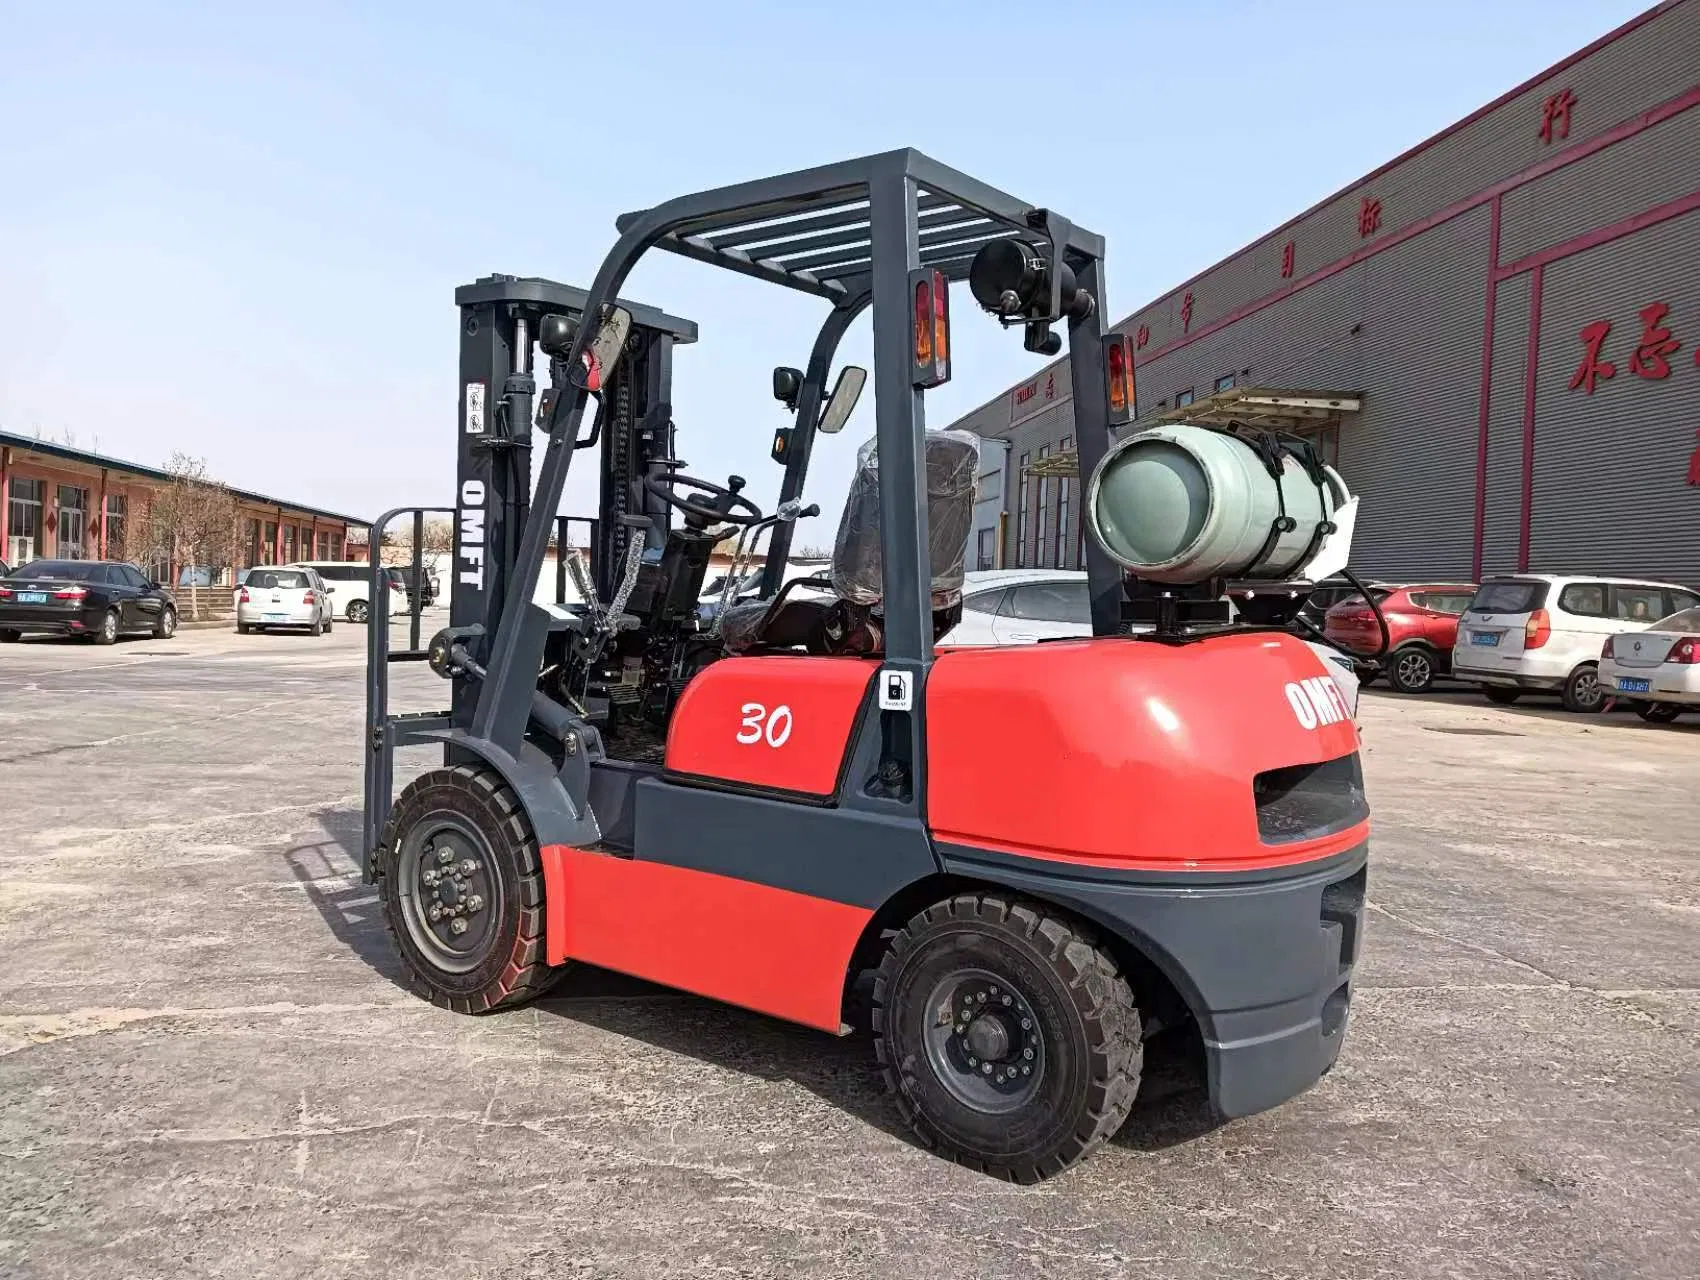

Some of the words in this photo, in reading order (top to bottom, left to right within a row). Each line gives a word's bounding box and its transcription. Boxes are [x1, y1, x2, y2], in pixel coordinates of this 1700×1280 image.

[1567, 302, 1700, 396] 不忘
[460, 480, 485, 591] OMFT
[736, 703, 793, 748] 30
